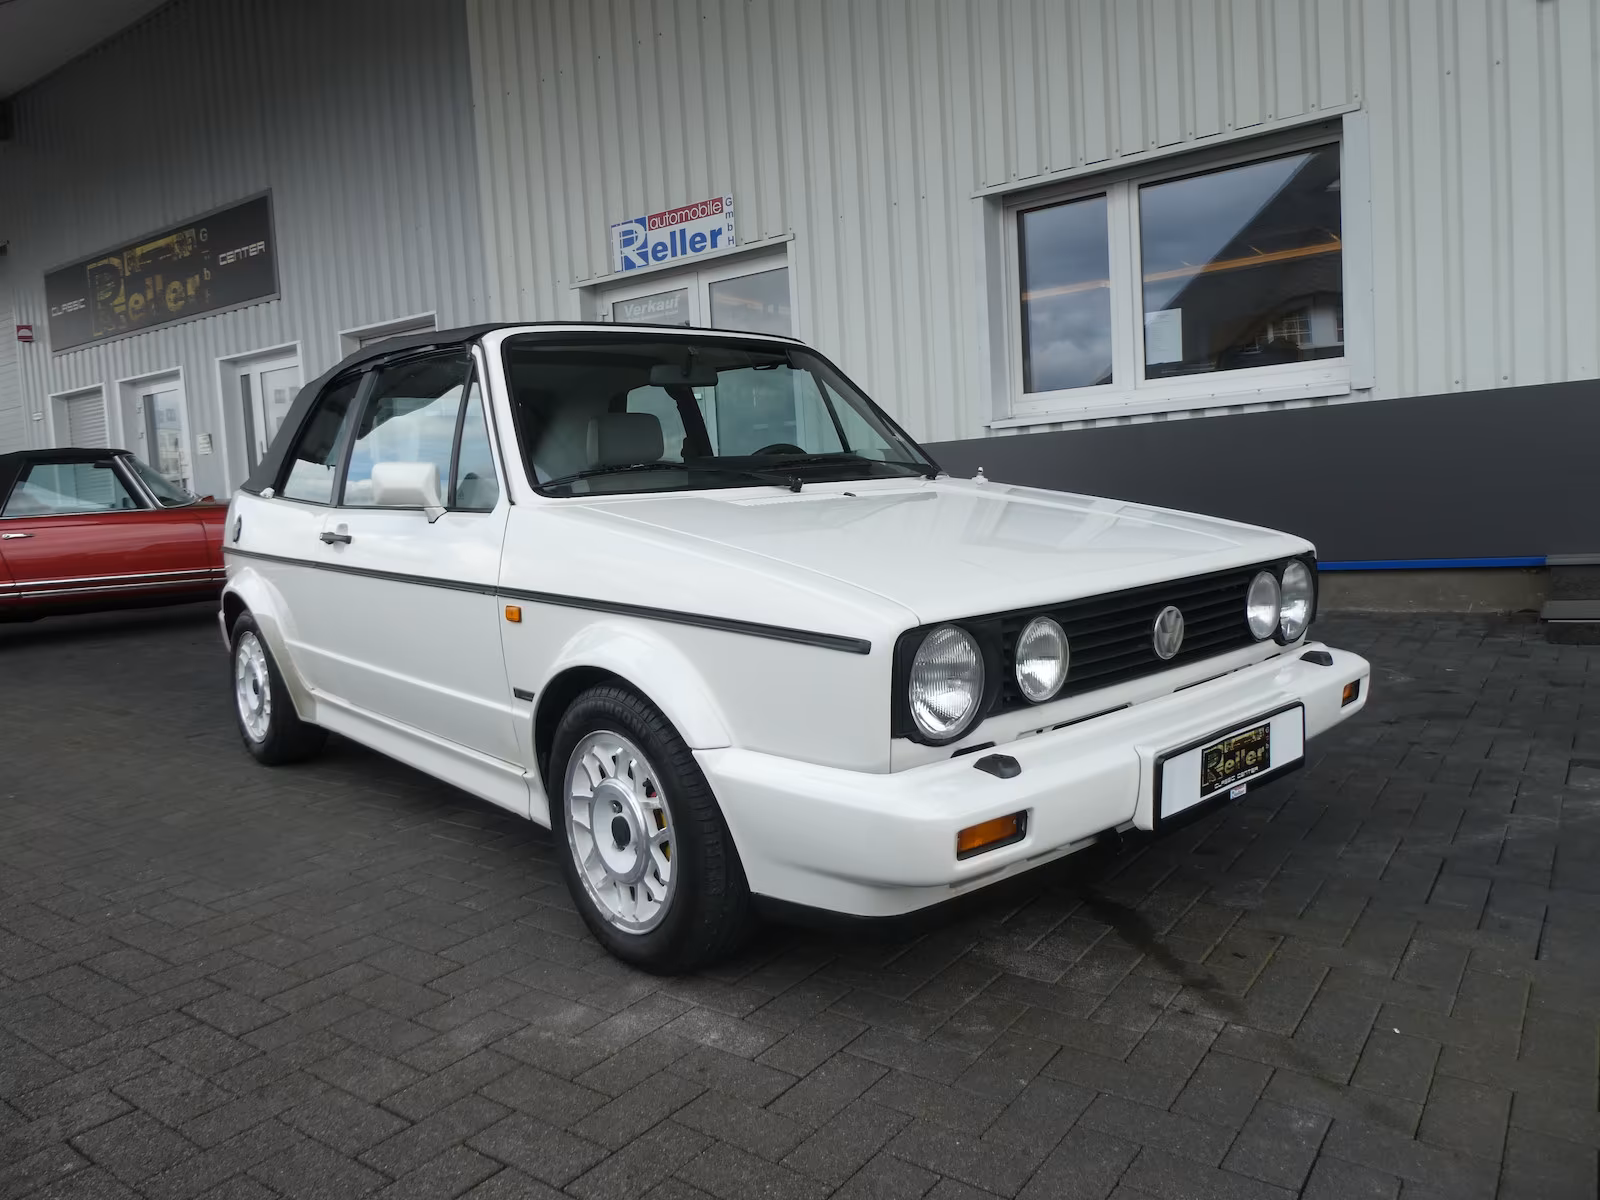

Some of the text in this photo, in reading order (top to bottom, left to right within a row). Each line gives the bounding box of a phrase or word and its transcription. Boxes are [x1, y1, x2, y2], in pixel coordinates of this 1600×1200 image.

[649, 199, 723, 230] automobile
[725, 197, 736, 247] GmbH
[218, 240, 265, 266] CENTER
[611, 217, 723, 272] Reller
[51, 297, 86, 317] CLASSIC
[623, 294, 681, 317] Verkauf
